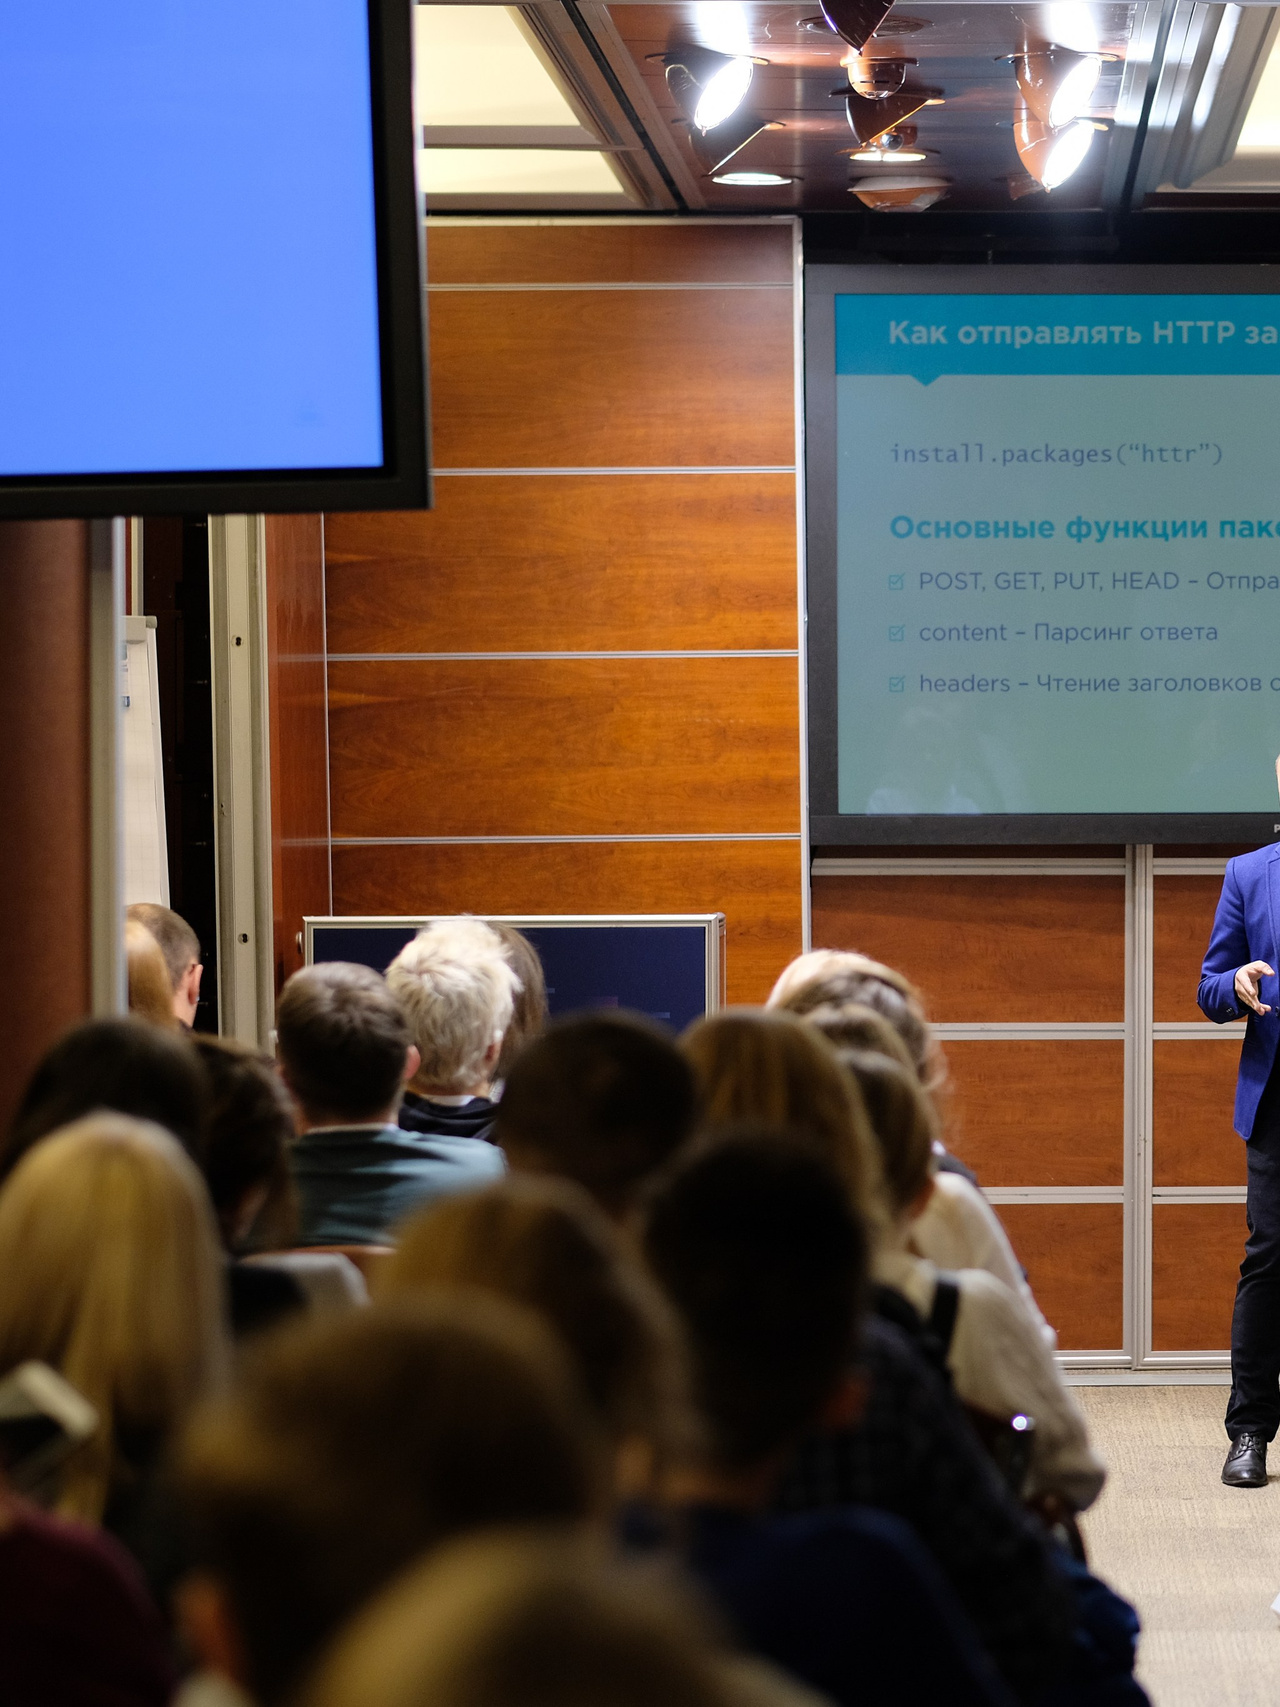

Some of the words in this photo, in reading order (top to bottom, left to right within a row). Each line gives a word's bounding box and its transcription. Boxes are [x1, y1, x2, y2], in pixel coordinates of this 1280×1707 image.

[889, 320, 947, 345] Как
[957, 325, 1141, 348] отправлять
[1153, 320, 1236, 344] HTTP
[890, 515, 1055, 539] Основные
[1066, 515, 1208, 543] функции
[919, 571, 986, 592] POST,
[994, 571, 1045, 592] GET,
[1054, 571, 1104, 592] PUT,
[1112, 571, 1180, 590] HEAD
[919, 624, 1008, 642] content
[1034, 622, 1133, 645] Парсинг
[1139, 626, 1219, 642] ответа
[919, 673, 1011, 693] headers
[1036, 674, 1121, 693] Чтение
[1128, 676, 1263, 695] заголовков
